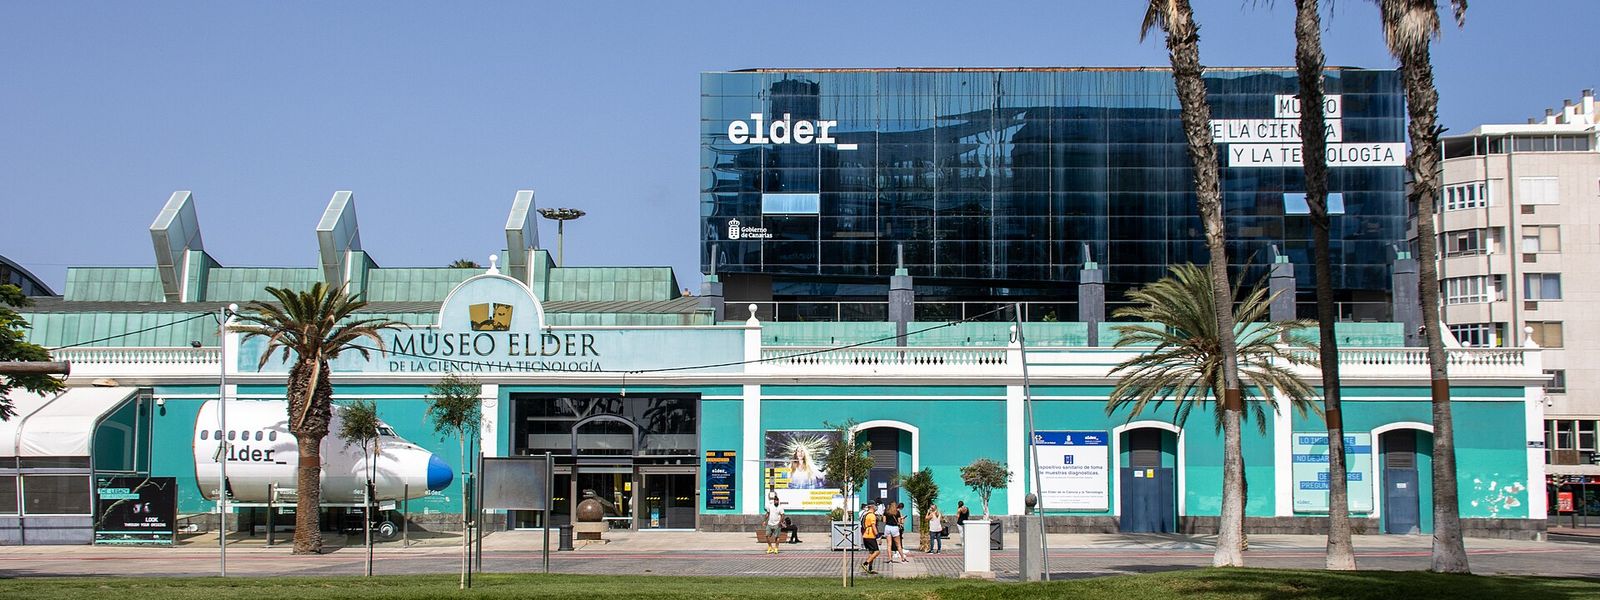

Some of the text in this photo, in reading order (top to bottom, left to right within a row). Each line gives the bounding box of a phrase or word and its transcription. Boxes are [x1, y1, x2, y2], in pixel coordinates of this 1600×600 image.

[1280, 98, 1338, 114] MUO
[1229, 123, 1251, 139] LA
[1257, 123, 1337, 139] CIENA
[1233, 144, 1395, 163] Y LA TEOLOGÍA
[392, 332, 600, 357] MUSEO ELDER
[389, 358, 603, 373] DE LA CIENCIA Y LA TECNOLOGÍA
[227, 445, 287, 465] lder_
